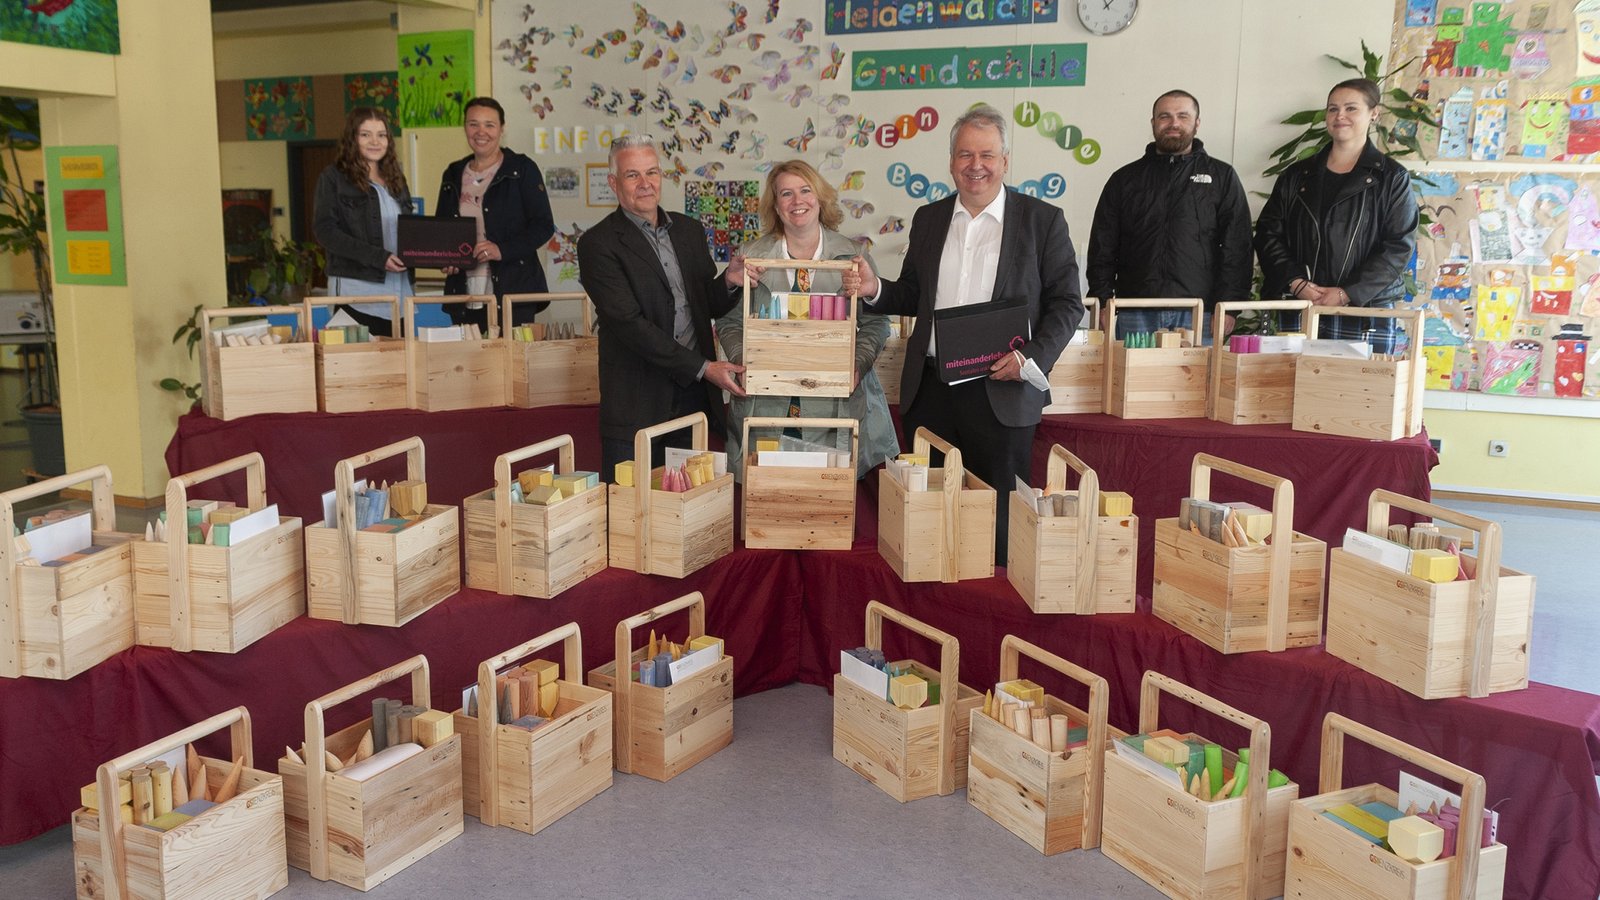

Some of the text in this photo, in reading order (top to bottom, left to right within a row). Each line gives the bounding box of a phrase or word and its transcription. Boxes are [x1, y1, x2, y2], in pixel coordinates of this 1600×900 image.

[854, 49, 1080, 88] Grundschule
[881, 101, 1096, 159] Ein hule
